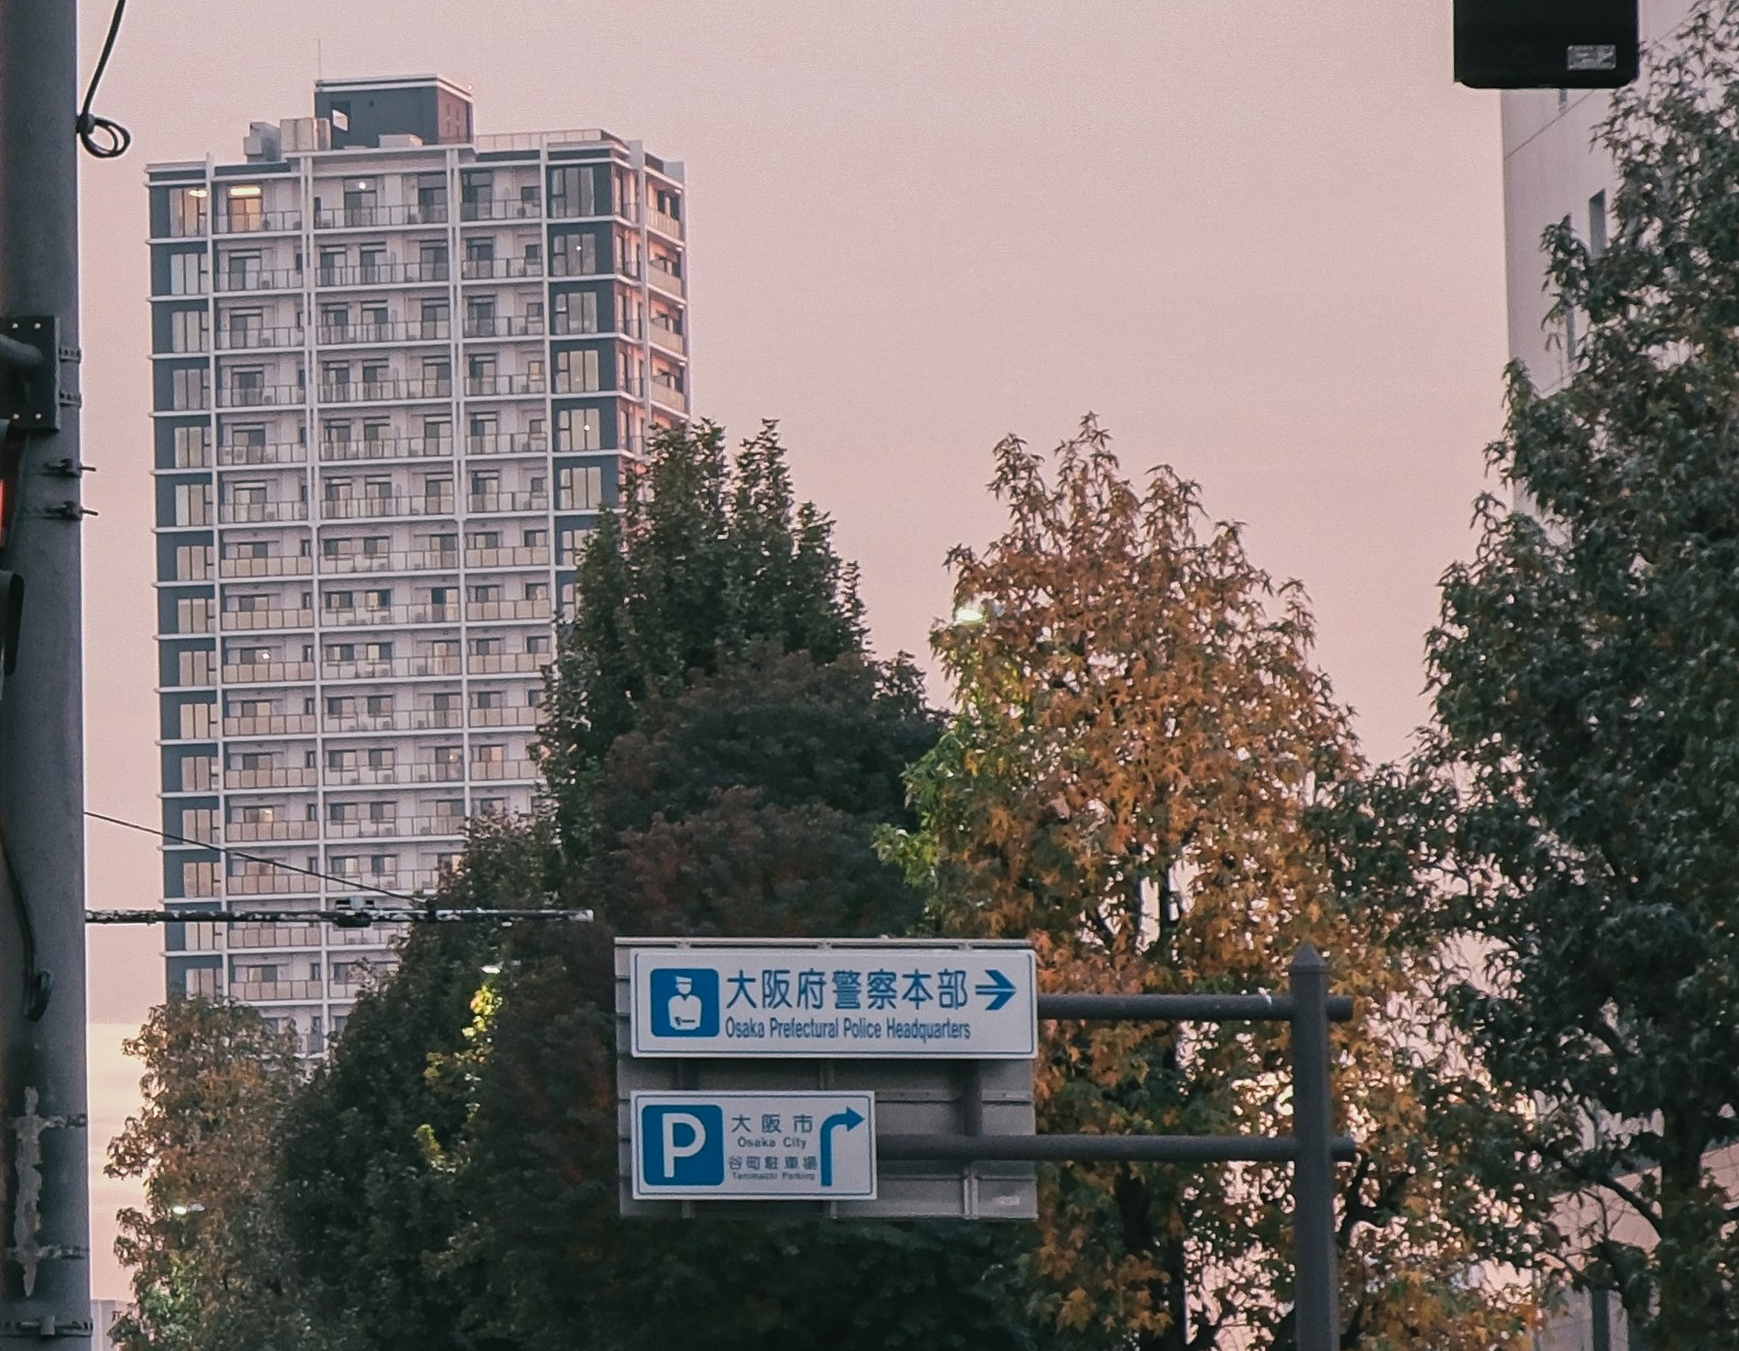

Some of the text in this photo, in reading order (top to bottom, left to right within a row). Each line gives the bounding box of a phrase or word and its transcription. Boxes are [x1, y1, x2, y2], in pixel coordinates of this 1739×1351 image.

[725, 967, 968, 1011] 大阪府警察本部
[725, 1017, 972, 1042] Osaka Prefectural Police Headquarters
[730, 1113, 815, 1134] 大阪市
[737, 1136, 807, 1150] Osaka City
